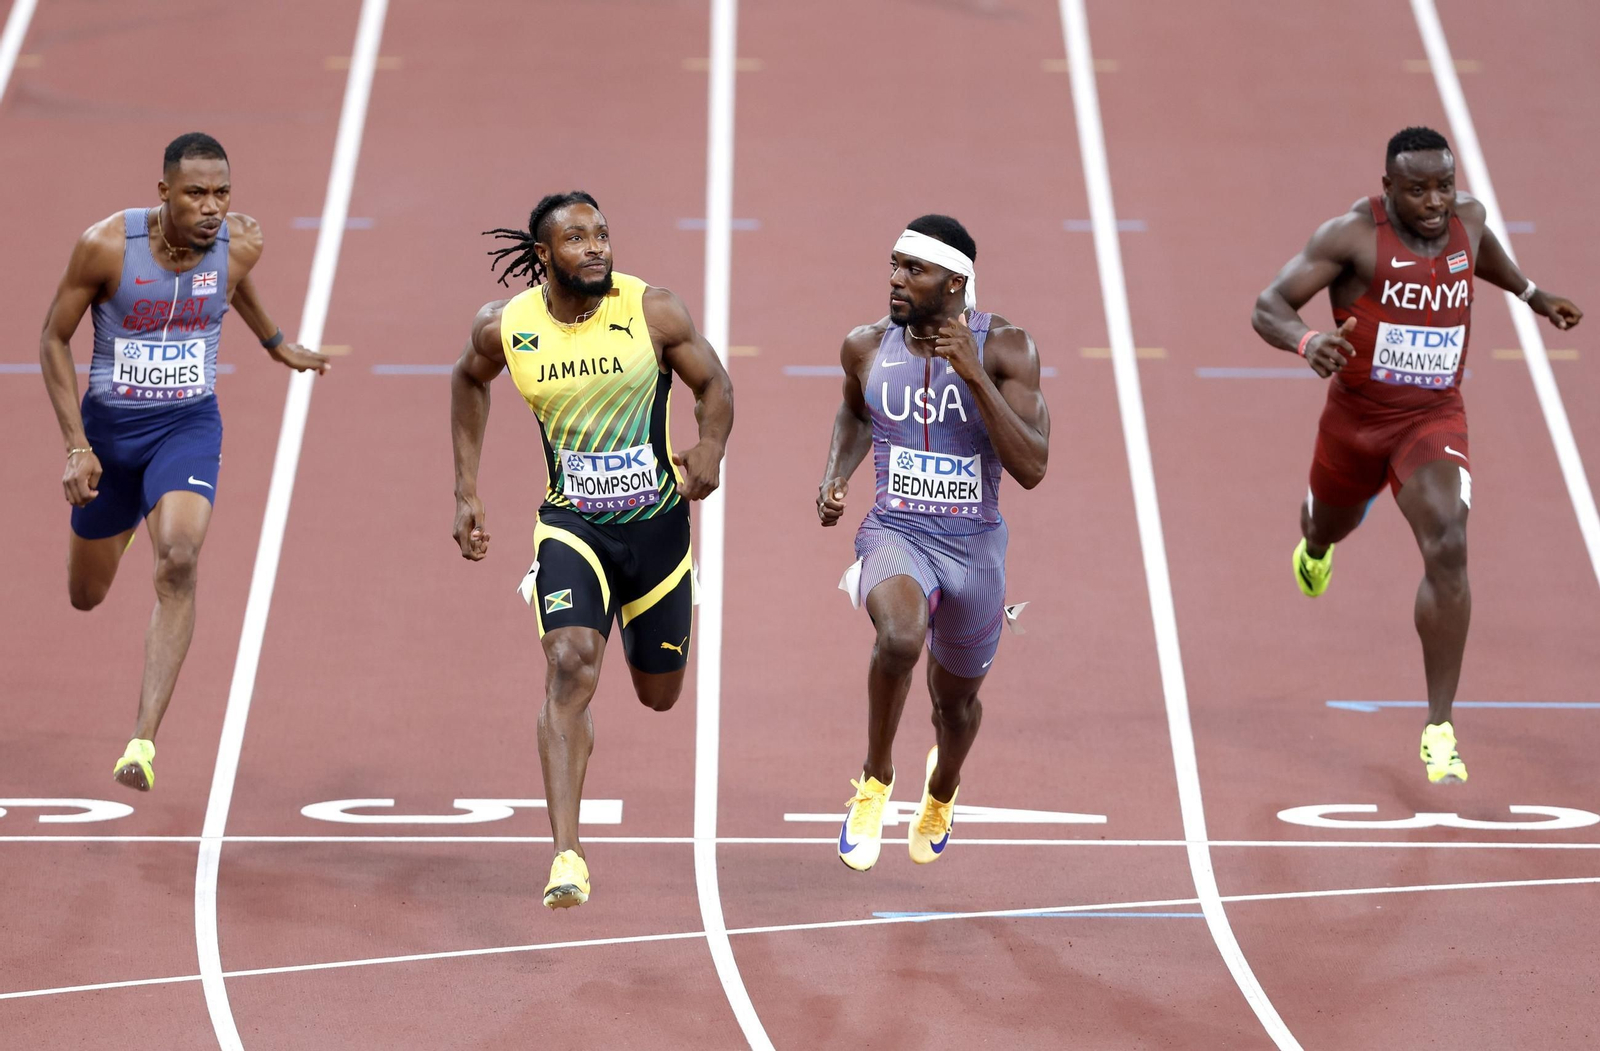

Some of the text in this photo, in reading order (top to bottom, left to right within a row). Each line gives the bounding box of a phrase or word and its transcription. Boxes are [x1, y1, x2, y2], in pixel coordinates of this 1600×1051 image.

[133, 297, 208, 317] GREAT
[1381, 279, 1469, 311] KENYA
[122, 314, 209, 332] BRITAIN
[1405, 329, 1459, 348] TDK
[142, 342, 198, 361] TDK
[1379, 348, 1458, 371] OMANYALA
[119, 363, 199, 385] HUGHES
[537, 356, 624, 383] JAMAICA
[881, 381, 967, 424] USA
[583, 449, 647, 472] TDK
[914, 453, 976, 478] TDK
[567, 469, 654, 495] THOMPSON
[892, 473, 979, 500] BEDNAREK
[1277, 804, 1600, 830] 3
